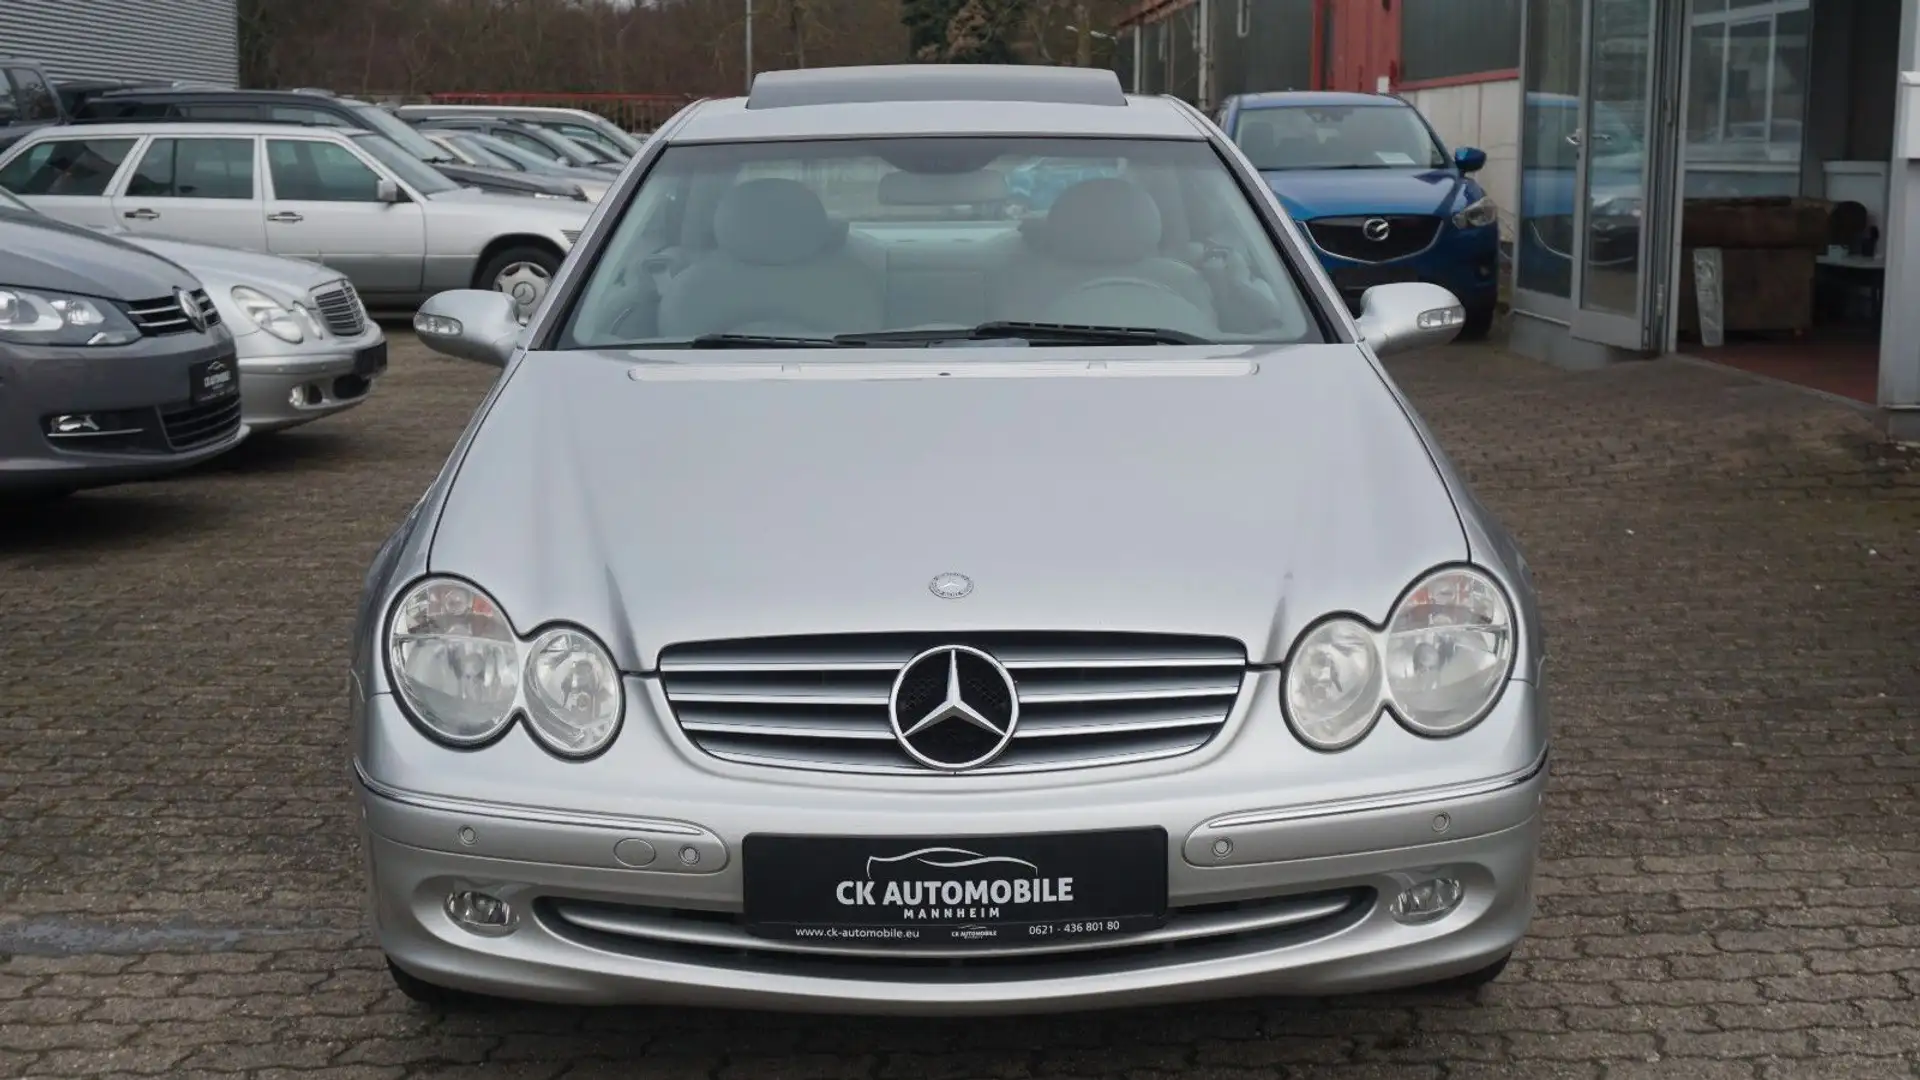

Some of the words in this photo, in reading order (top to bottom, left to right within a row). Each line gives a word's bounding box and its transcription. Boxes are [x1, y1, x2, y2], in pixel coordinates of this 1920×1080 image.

[836, 880, 876, 905] CK
[882, 877, 1074, 905] AUTOMOBILE
[903, 907, 1000, 920] MANNHEIM
[795, 927, 920, 939] www.ck-automobile.eu
[1028, 925, 1053, 935] 0621
[1063, 922, 1083, 933] 436
[1086, 921, 1103, 932] 801
[1107, 920, 1120, 930] 80
